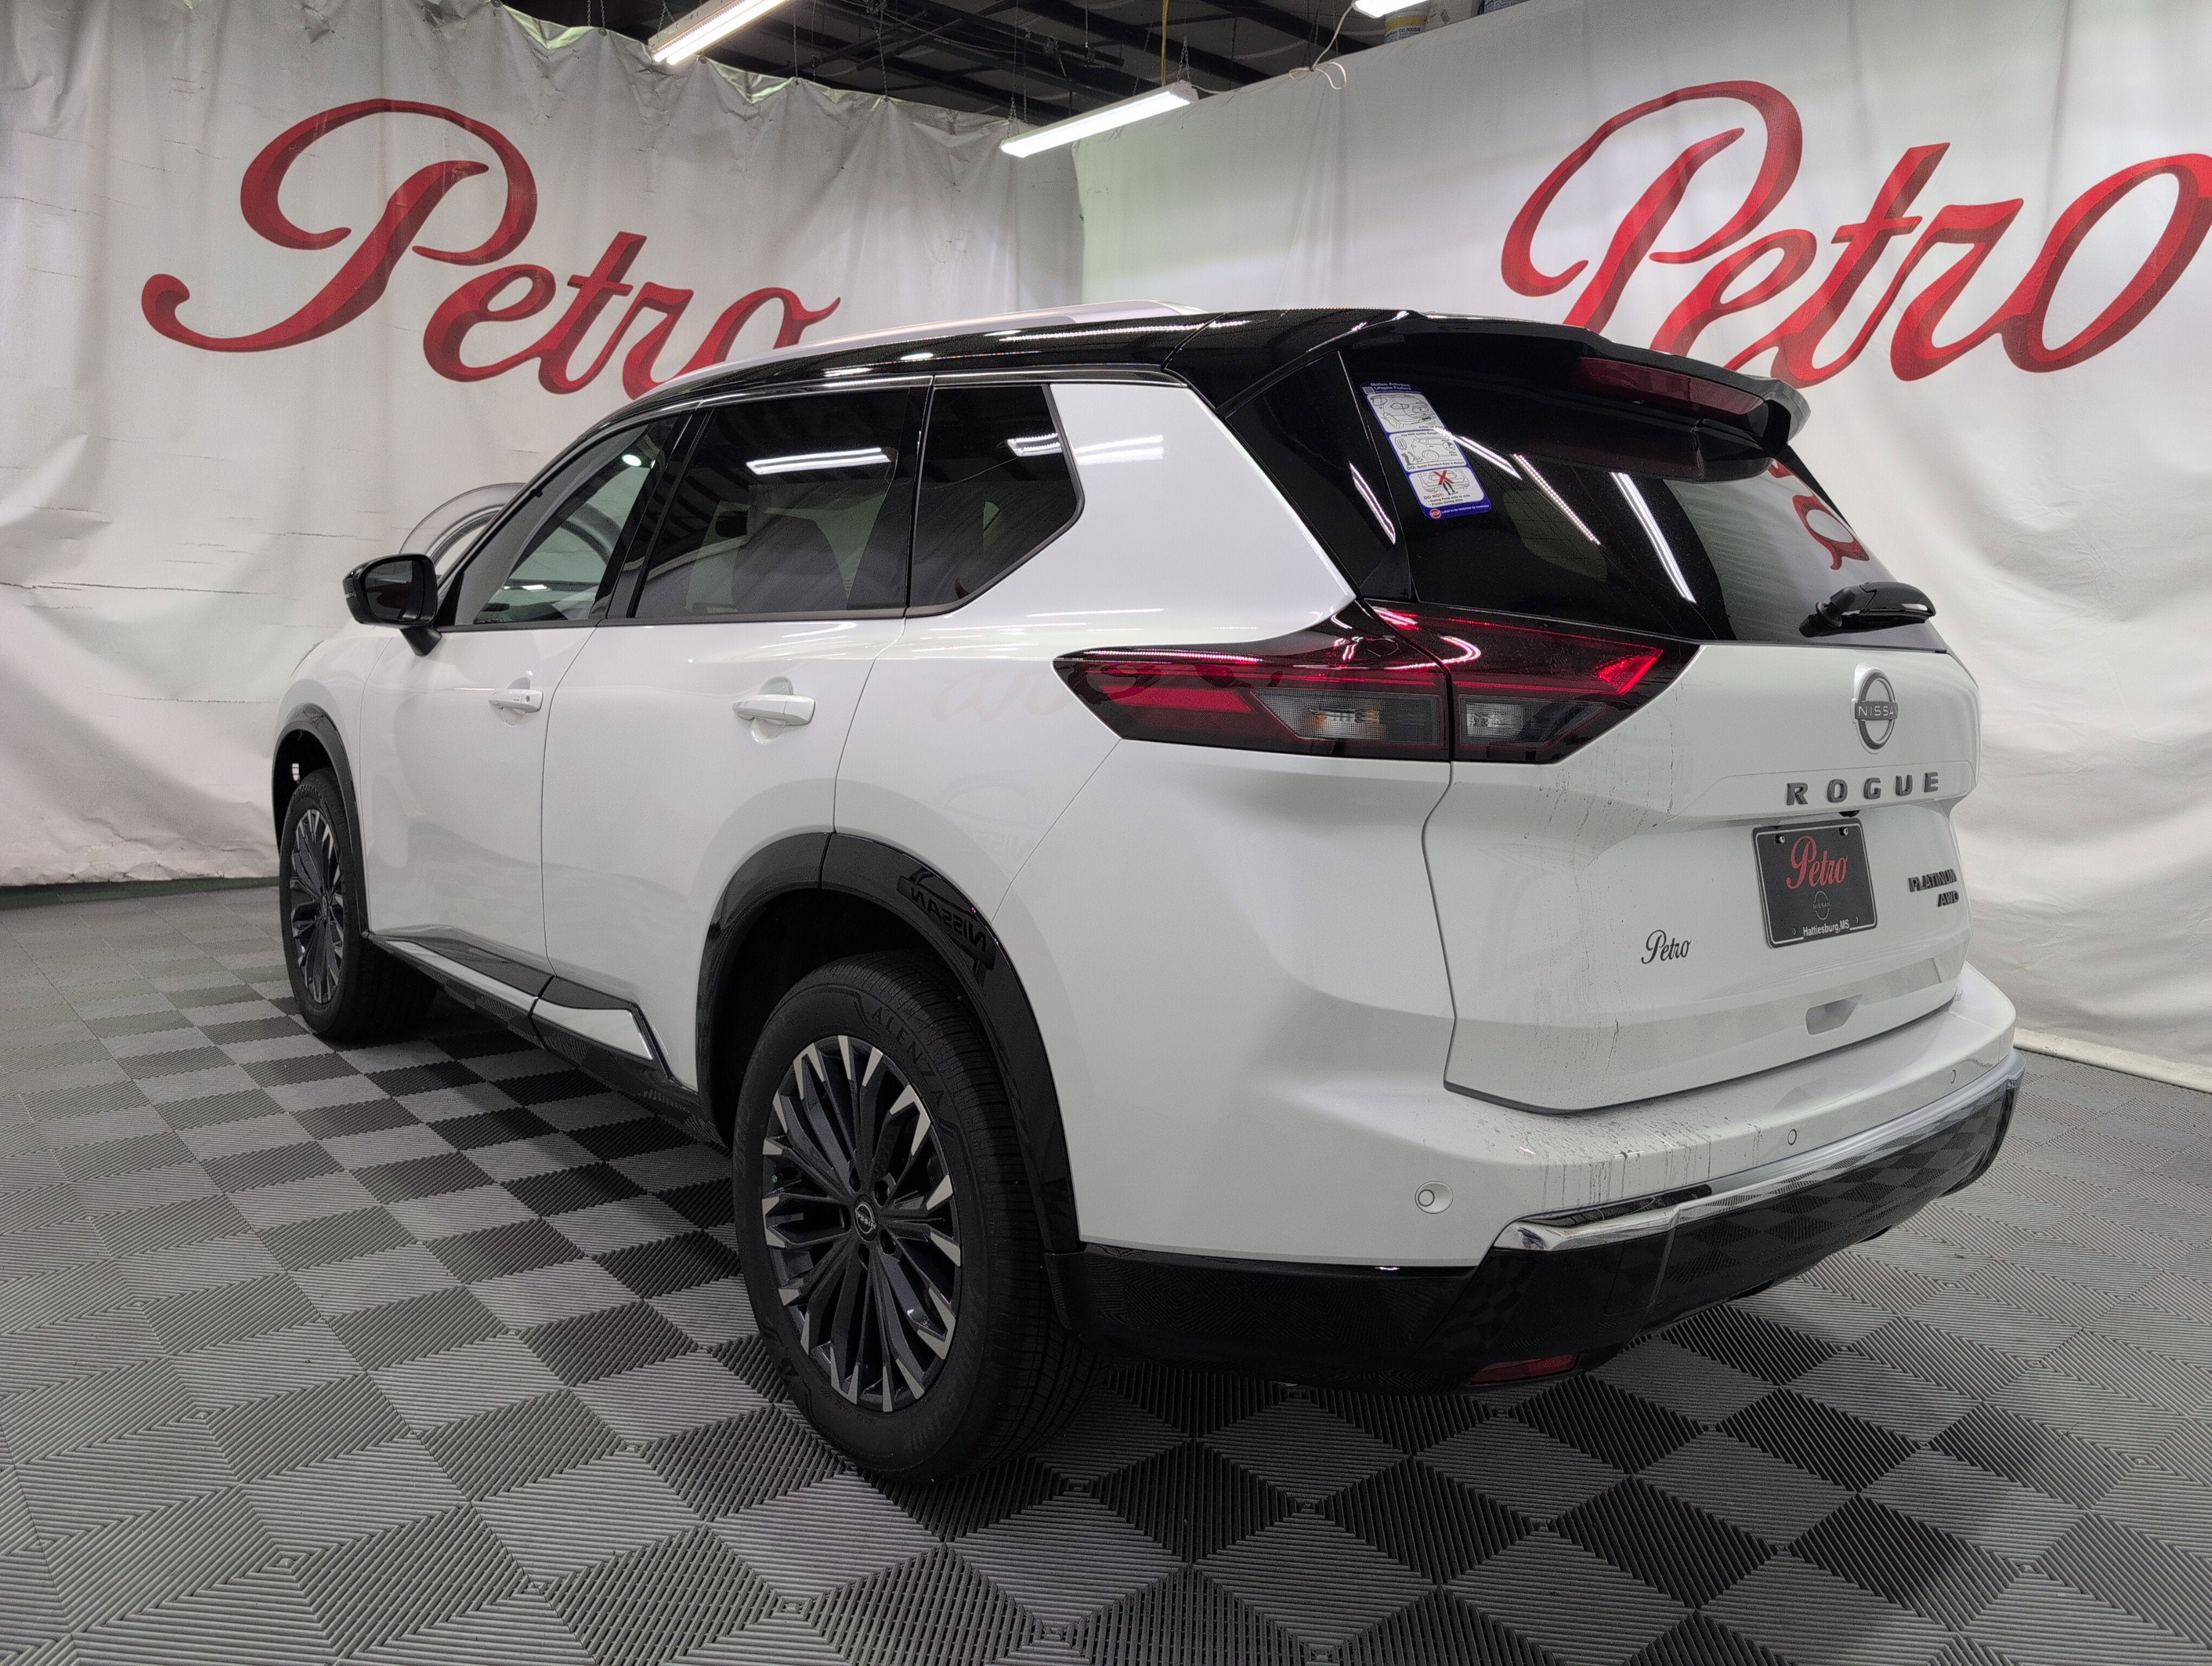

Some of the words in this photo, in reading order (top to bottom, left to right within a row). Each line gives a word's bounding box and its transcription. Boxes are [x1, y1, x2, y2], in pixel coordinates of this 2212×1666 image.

[142, 98, 840, 401] Petro
[1501, 80, 2212, 389] Petro
[1858, 706, 1898, 716] NISSAN
[1786, 771, 1939, 806] ROGUE
[1785, 835, 1849, 889] Petro
[1908, 869, 1957, 892] PLATINUM
[1812, 901, 1831, 909] NISSAN
[1937, 890, 1959, 907] AWD
[1641, 930, 1692, 964] Petro
[871, 1007, 944, 1106] ALENZA
